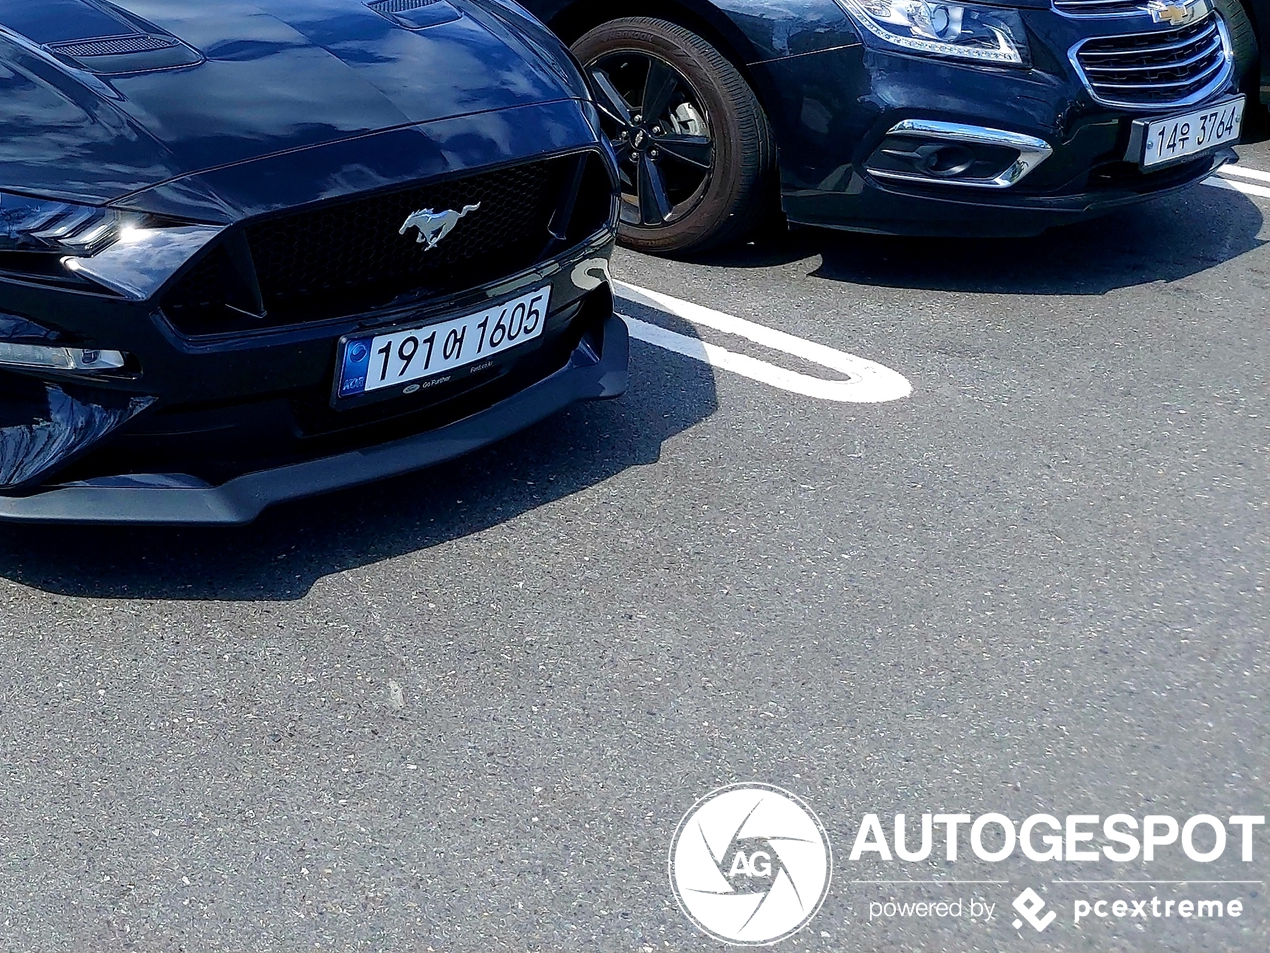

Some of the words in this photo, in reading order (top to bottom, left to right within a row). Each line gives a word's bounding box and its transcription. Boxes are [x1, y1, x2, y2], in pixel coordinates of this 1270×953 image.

[1156, 122, 1190, 158] 14우
[1196, 106, 1235, 146] 3764
[376, 324, 468, 382] 191어
[476, 294, 543, 354] 1605
